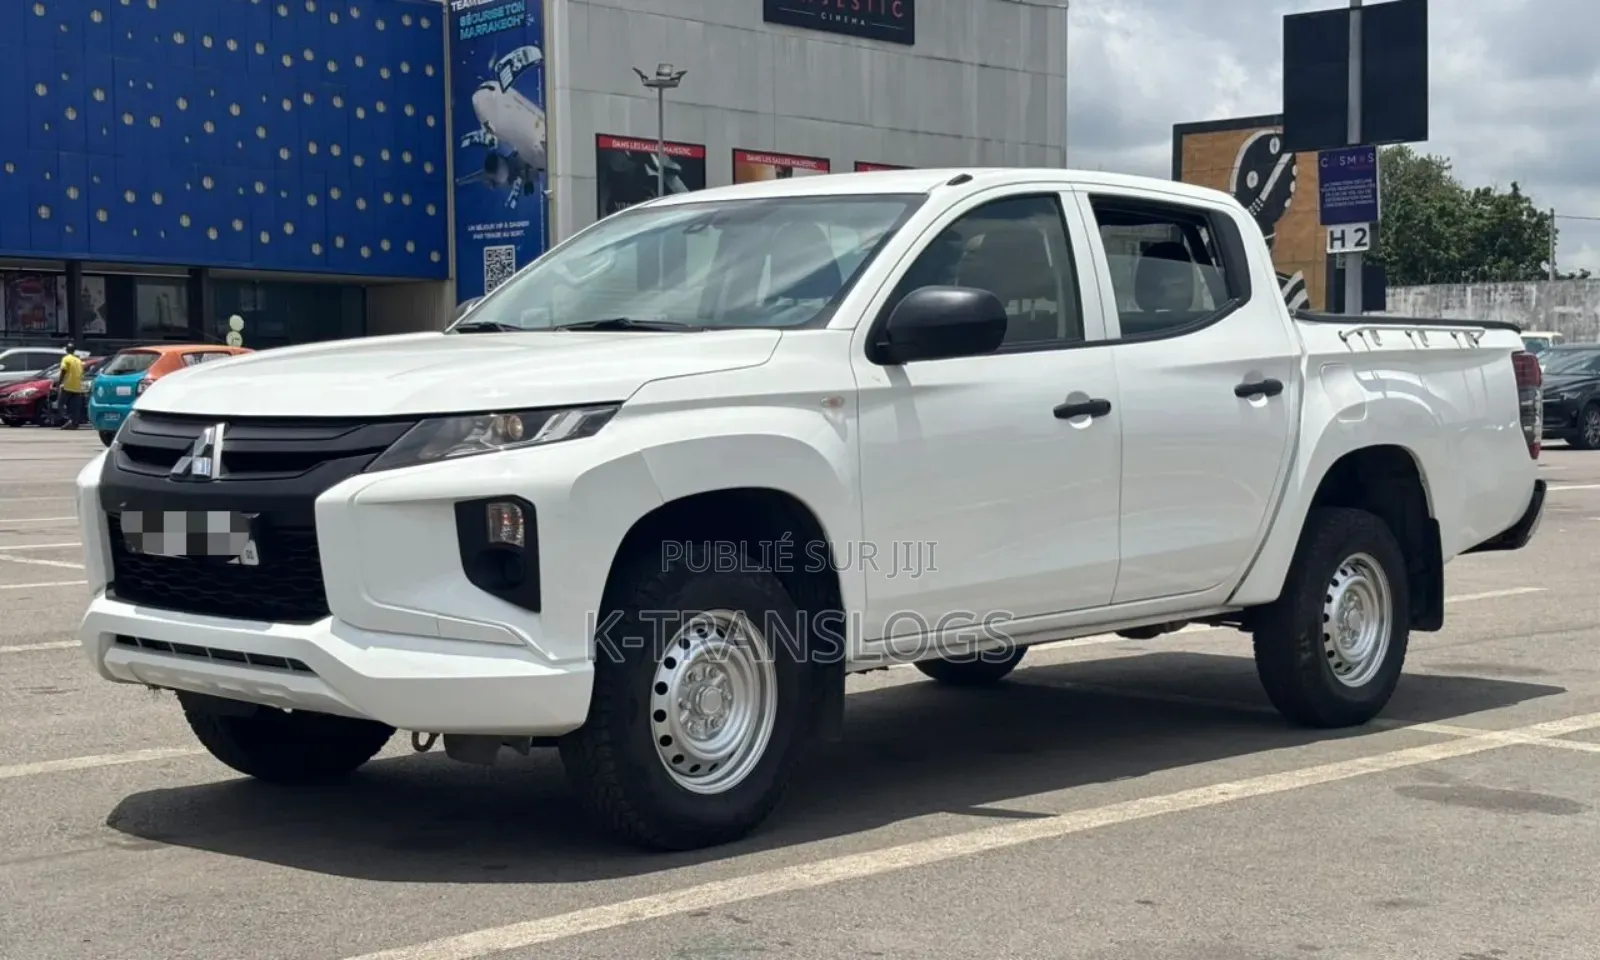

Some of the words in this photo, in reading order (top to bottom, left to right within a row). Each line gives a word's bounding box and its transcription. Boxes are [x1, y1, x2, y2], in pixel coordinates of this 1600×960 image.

[820, 12, 866, 26] CINEMA
[641, 142, 660, 152] SALLE
[1320, 153, 1375, 168] CSMS
